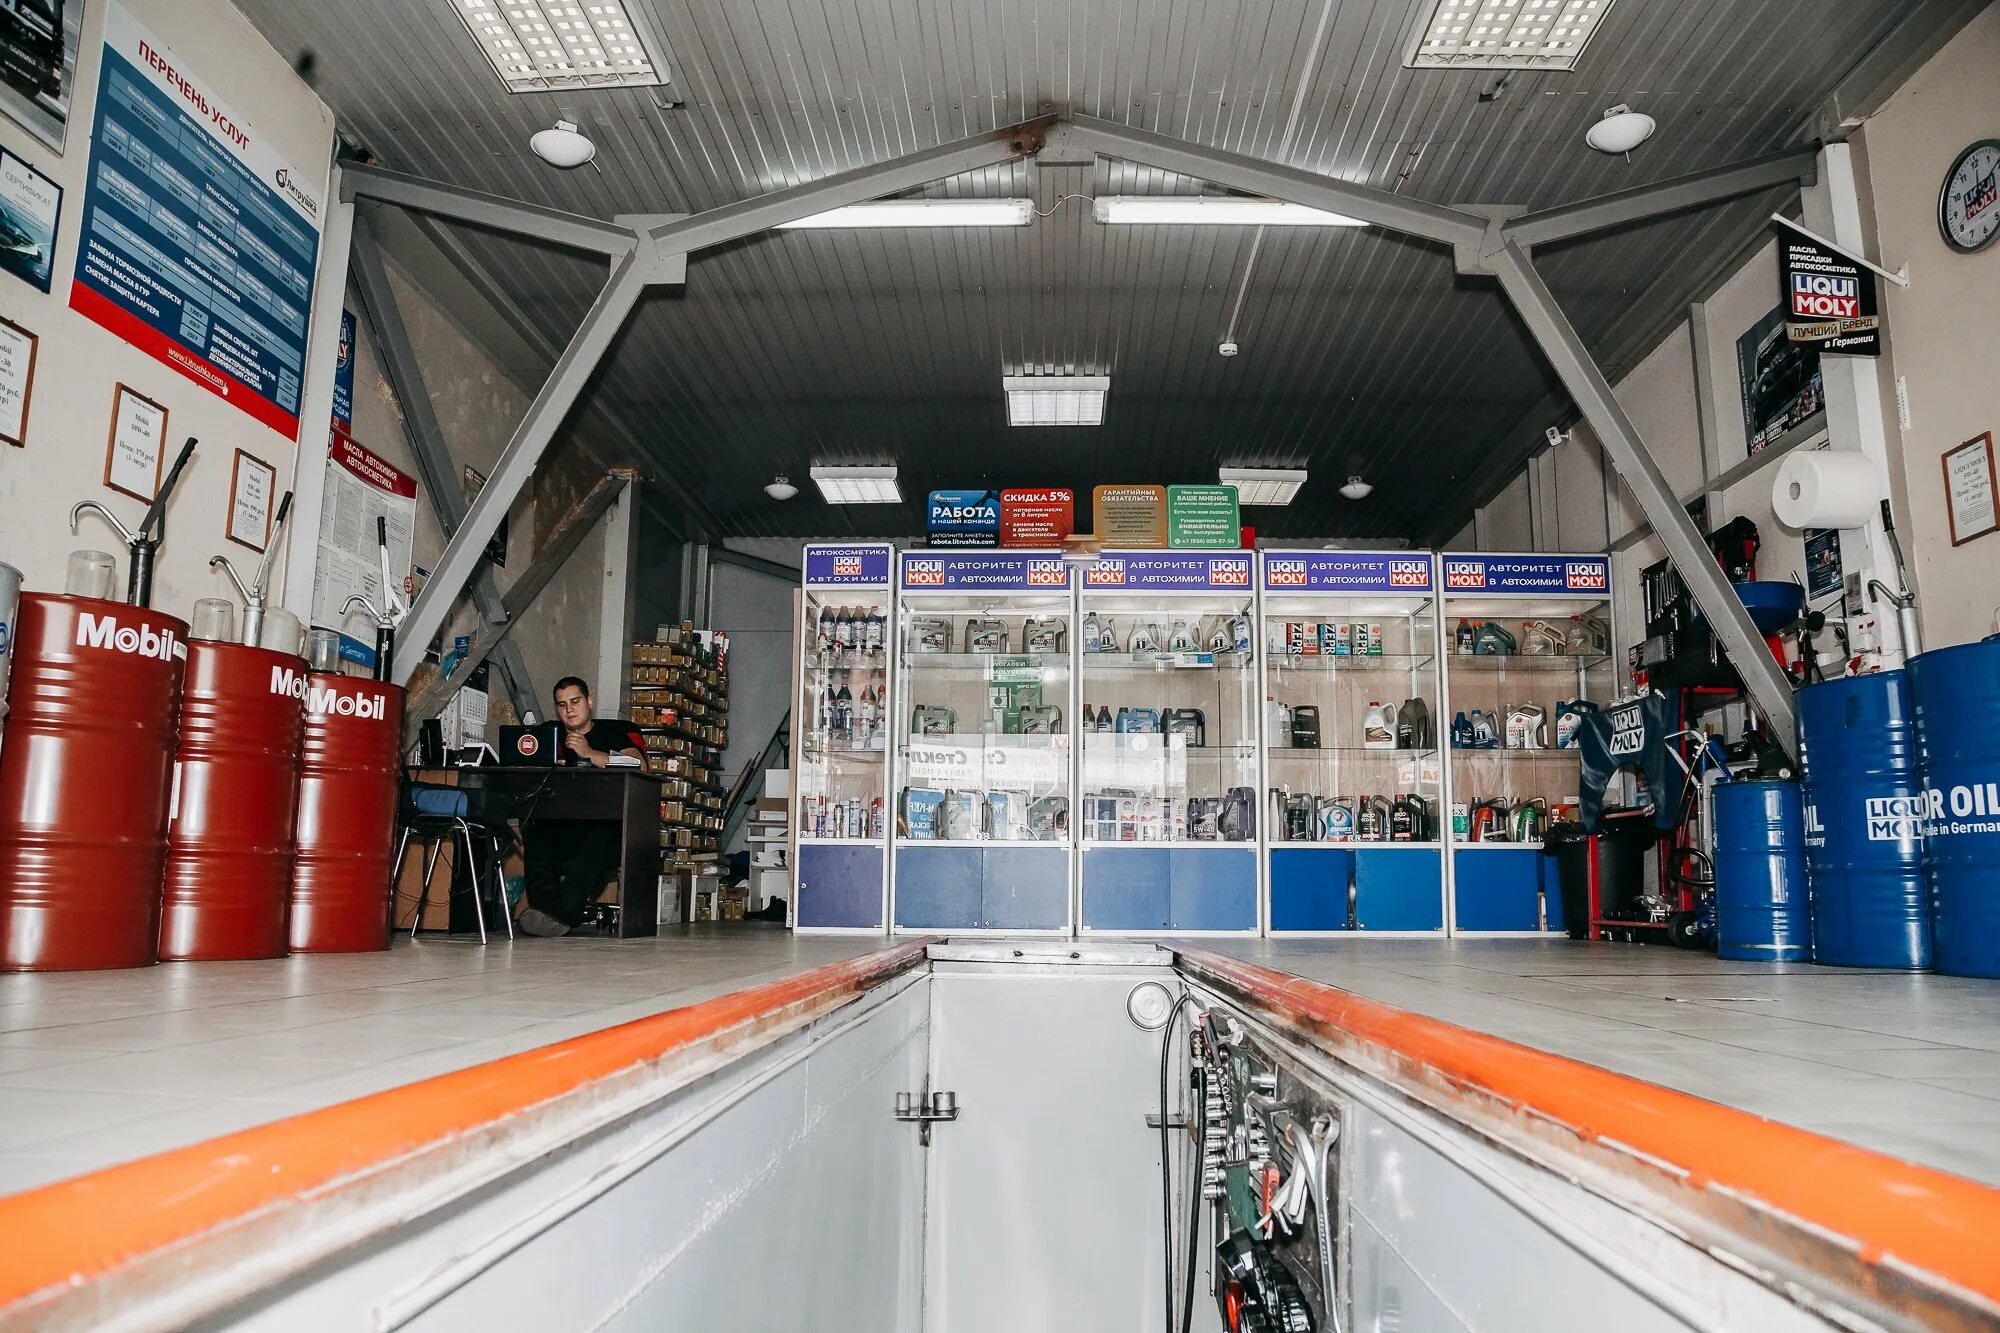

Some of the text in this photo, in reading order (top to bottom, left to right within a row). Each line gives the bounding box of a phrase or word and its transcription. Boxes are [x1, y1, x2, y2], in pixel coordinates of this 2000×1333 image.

[139, 39, 250, 150] ПЕРЕЧЕНЬ УСЛУГ
[1971, 158, 1979, 170] 12
[1960, 174, 1967, 183] 11
[5, 171, 51, 207] СЕРТИФИКАТ
[205, 182, 240, 216] ТРАНСМИССИЯ
[287, 180, 317, 214] Литрушка
[1953, 192, 1961, 203] 10
[1967, 188, 1997, 219] MOLY
[1953, 211, 1958, 220] 9
[1994, 211, 2000, 220] 5
[1960, 224, 1965, 233] 8
[1969, 229, 1975, 238] 7
[1983, 225, 1988, 234] 6
[196, 220, 238, 258] ЗАМЕНА ФИЛЬТРА
[1789, 245, 1817, 254] МАСЛА
[1789, 254, 1832, 264] ПРИСАДКИ
[88, 237, 182, 307] ЗАМЕНА ТОРМОЗНОЙ ЖИДКОСТИ
[1790, 262, 1857, 274] АВТОКОСМЕТИКА
[86, 250, 150, 299] ЗАМЕНА МАСЛА В ГУР
[183, 255, 241, 303] ПРОМЫВКА ИНЖЕКТОРА
[84, 262, 160, 318] СНЯТИЕ ЗАЩИТЫ КАРТЕРА
[1796, 276, 1855, 297] LIQUI
[1796, 295, 1857, 316] MOLY
[213, 322, 233, 341] ЗАМЕНА
[1793, 318, 1873, 337] ЛУЧШИЙ БРЕНД
[1824, 335, 1874, 348] в Германии
[0, 344, 12, 355] obil
[339, 342, 348, 359] LY
[167, 344, 224, 387] www.Litrushka.com
[243, 373, 262, 392] САЛОНА
[343, 440, 398, 482] МАСЛА АВТОХИМИЯ
[346, 455, 393, 491] АВТОКОСМЕТИКА
[1004, 492, 1070, 502] СКИДКА 5%
[932, 507, 996, 518] РАБОТА
[835, 557, 861, 567] LIQUI
[908, 561, 943, 573] LIQUI
[1029, 561, 1065, 573] LIQUI
[1130, 561, 1204, 569] АВТОРИТЕТ
[1211, 561, 1246, 572] LIQUI
[1270, 562, 1305, 573] LIQUI
[1311, 562, 1384, 570] АВТОРИТЕТ
[1391, 562, 1426, 573] LIQUI
[835, 566, 861, 575] MOLY
[1448, 563, 1483, 574] LIQUI
[1489, 565, 1561, 573] АВТОРИТЕТ
[1568, 564, 1602, 575] LIQUI
[908, 573, 944, 584] MOLY
[1029, 573, 1066, 584] MOLY
[1089, 572, 1124, 583] MOLY
[1130, 575, 1205, 583] В АВТОХИМИИ
[1211, 572, 1247, 583] MOLY
[1270, 573, 1306, 584] MOLY
[1323, 576, 1385, 584] АВТОХИМИИ
[1392, 573, 1427, 584] MOLY
[1449, 574, 1484, 586] MOLY
[1501, 578, 1563, 586] АВТОХИМИИ
[1568, 575, 1604, 586] MOLY
[76, 612, 174, 662] Mobil
[270, 665, 308, 704] Mob
[308, 687, 386, 720] Mobil
[1614, 707, 1641, 731] LIQUI
[1612, 730, 1642, 752] MOLY
[1950, 783, 2000, 817] OIL
[1870, 799, 1922, 817] LIQU
[1872, 820, 1922, 838] MOL
[1940, 823, 1949, 835] in
